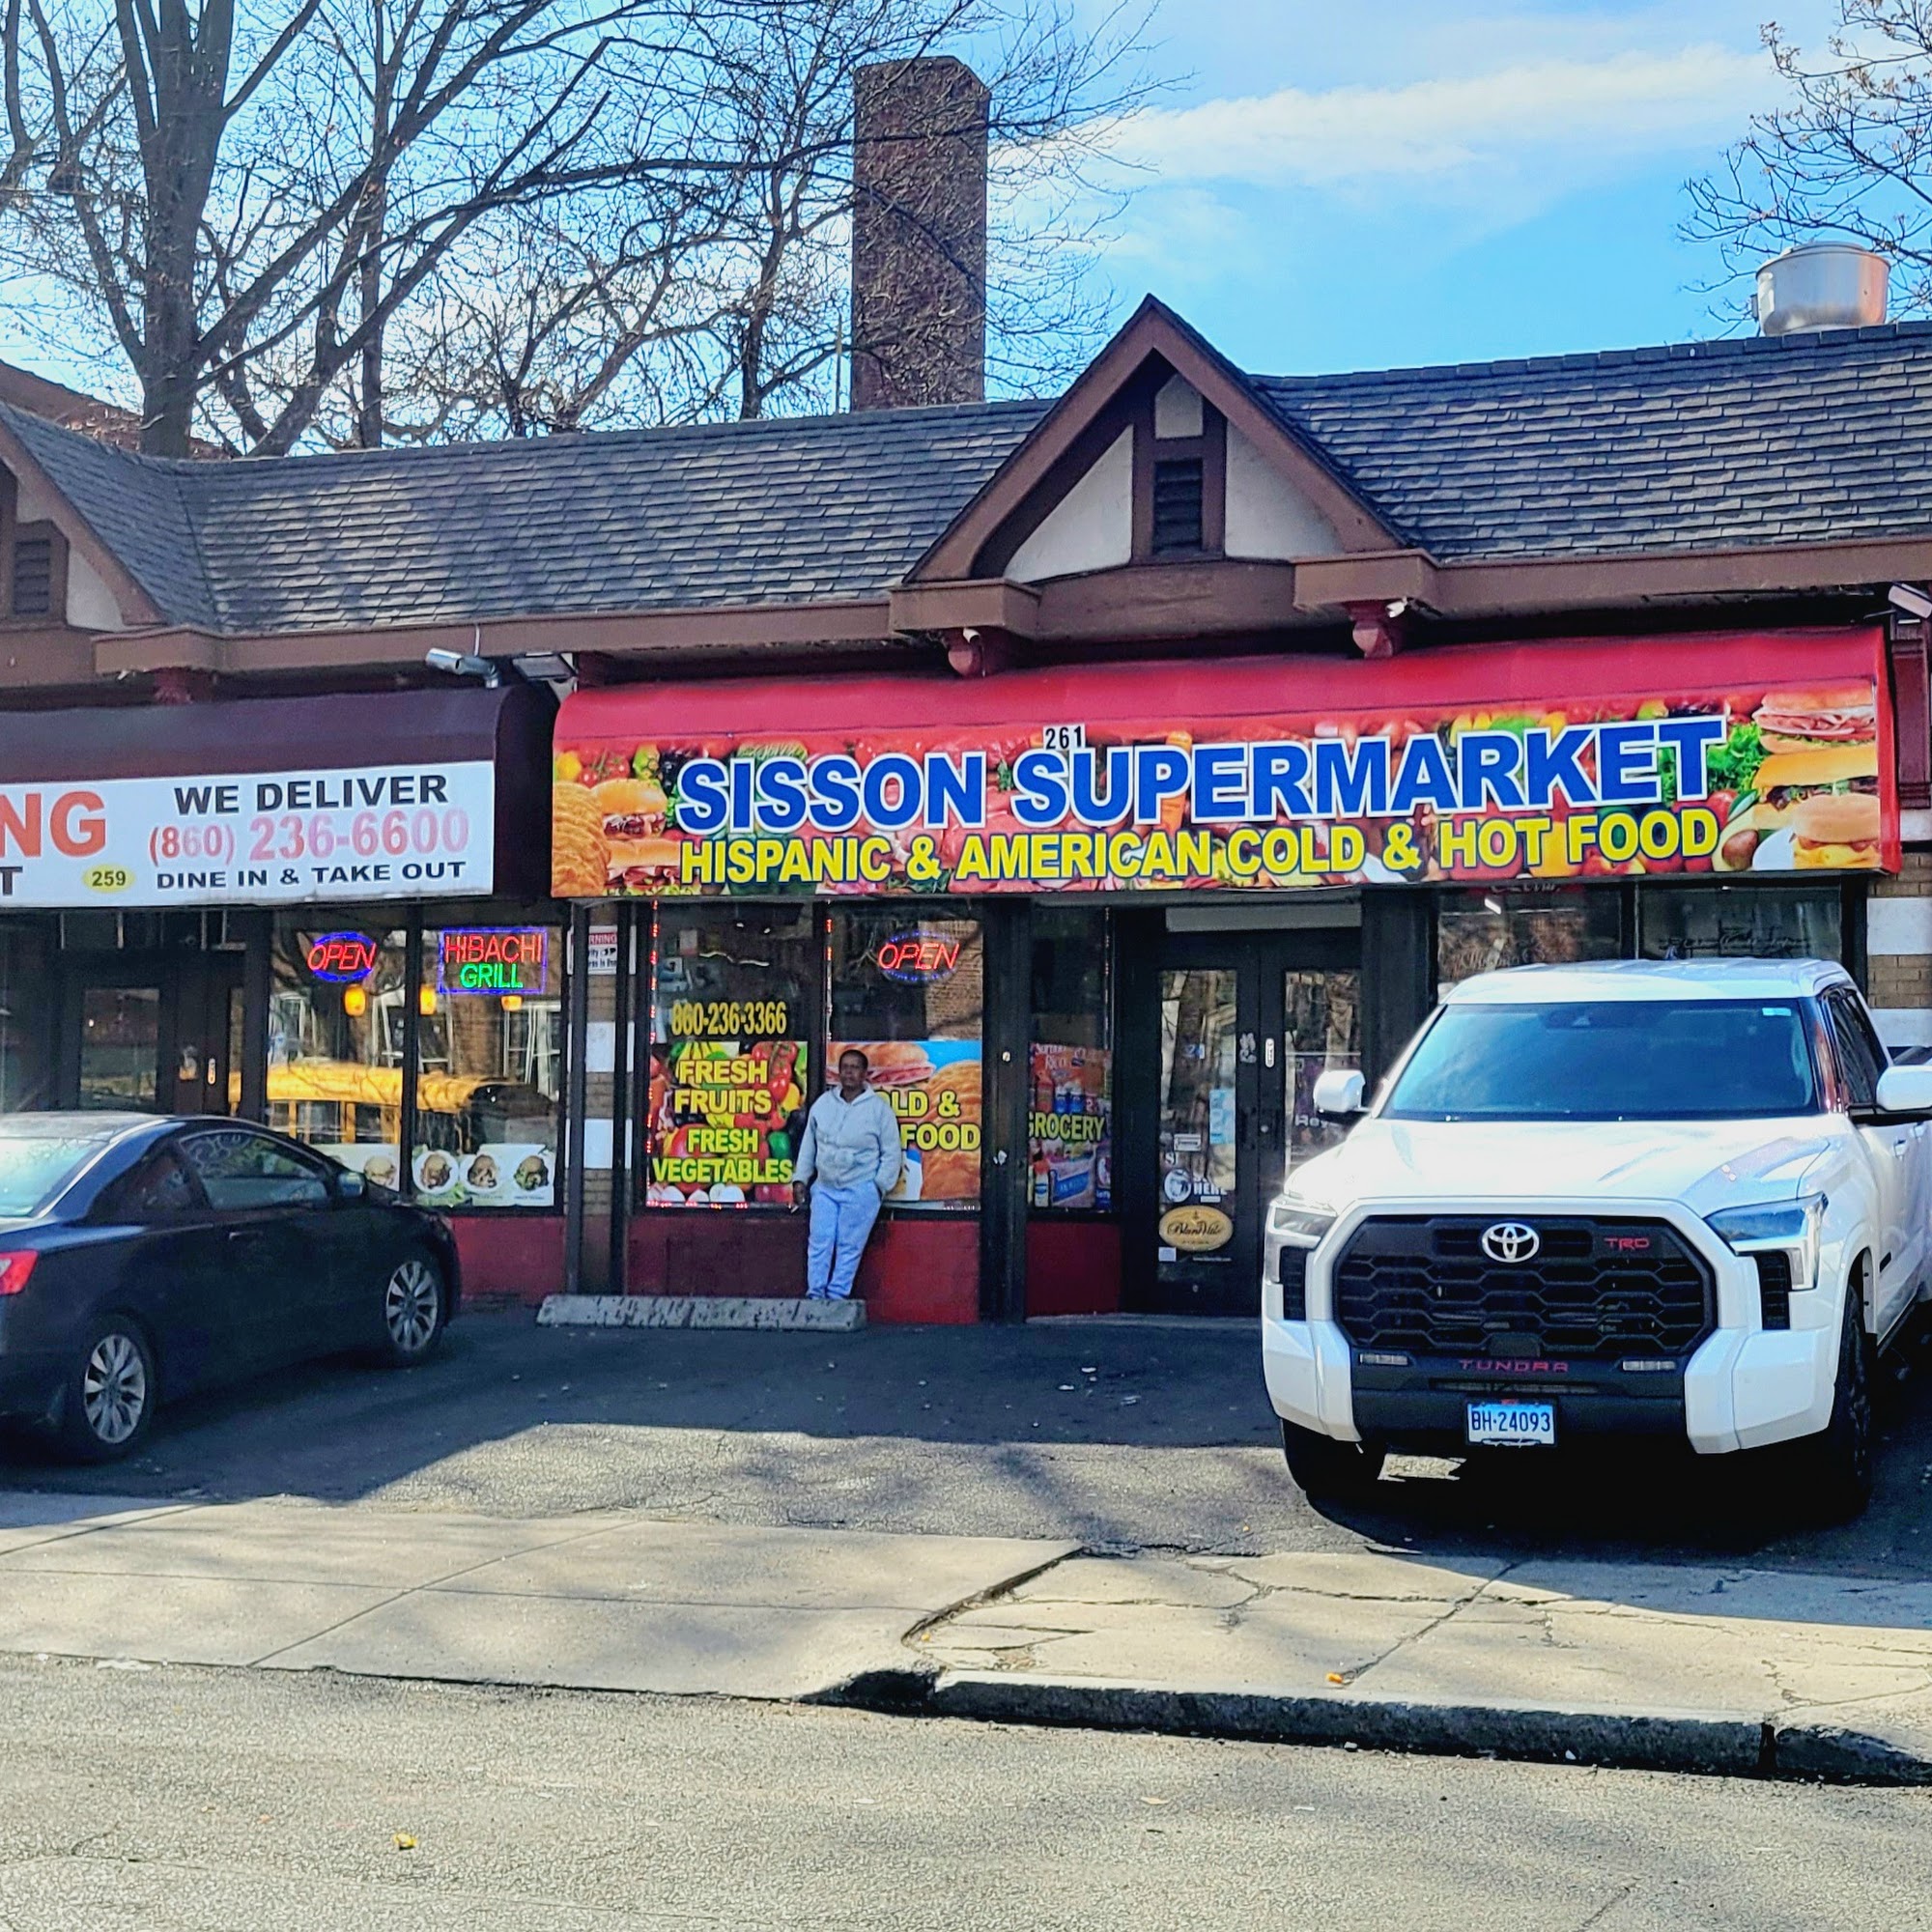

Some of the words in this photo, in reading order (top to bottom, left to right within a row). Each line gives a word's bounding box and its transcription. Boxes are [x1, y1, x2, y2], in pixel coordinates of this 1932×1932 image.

[1044, 724, 1083, 750] 261
[677, 750, 985, 832] SISSON
[1010, 715, 1727, 828] SUPERMARKET
[174, 784, 240, 815] WE
[256, 774, 448, 812] DELIVER
[0, 790, 106, 858] NG
[149, 823, 236, 867] (860)
[249, 809, 469, 862] 236-6600
[681, 834, 892, 884] HISPANIC
[906, 832, 942, 879] &
[954, 830, 1213, 881] AMERICAN
[1226, 825, 1366, 875] COLD
[1382, 821, 1421, 870] &
[1438, 815, 1552, 868] HOT
[1567, 807, 1719, 862] FOOD
[91, 870, 127, 887] 259
[156, 871, 227, 889] DINE
[238, 869, 269, 887] IN
[279, 867, 300, 885] &
[311, 864, 391, 884] TAKE
[402, 861, 467, 880] OUT
[307, 942, 377, 972] OPEN
[444, 934, 543, 964] HIBACHI
[877, 942, 960, 972] OPEN
[459, 962, 525, 989] GRILL
[678, 1059, 769, 1085] FRESH
[673, 1089, 773, 1115] FRUITS
[937, 1090, 961, 1118] &
[687, 1128, 759, 1153] FRESH
[900, 1122, 981, 1151] FOOD
[651, 1157, 794, 1184] VEGETABLES
[1604, 1236, 1650, 1251] TRD
[1460, 1358, 1569, 1373] TUNDRA
